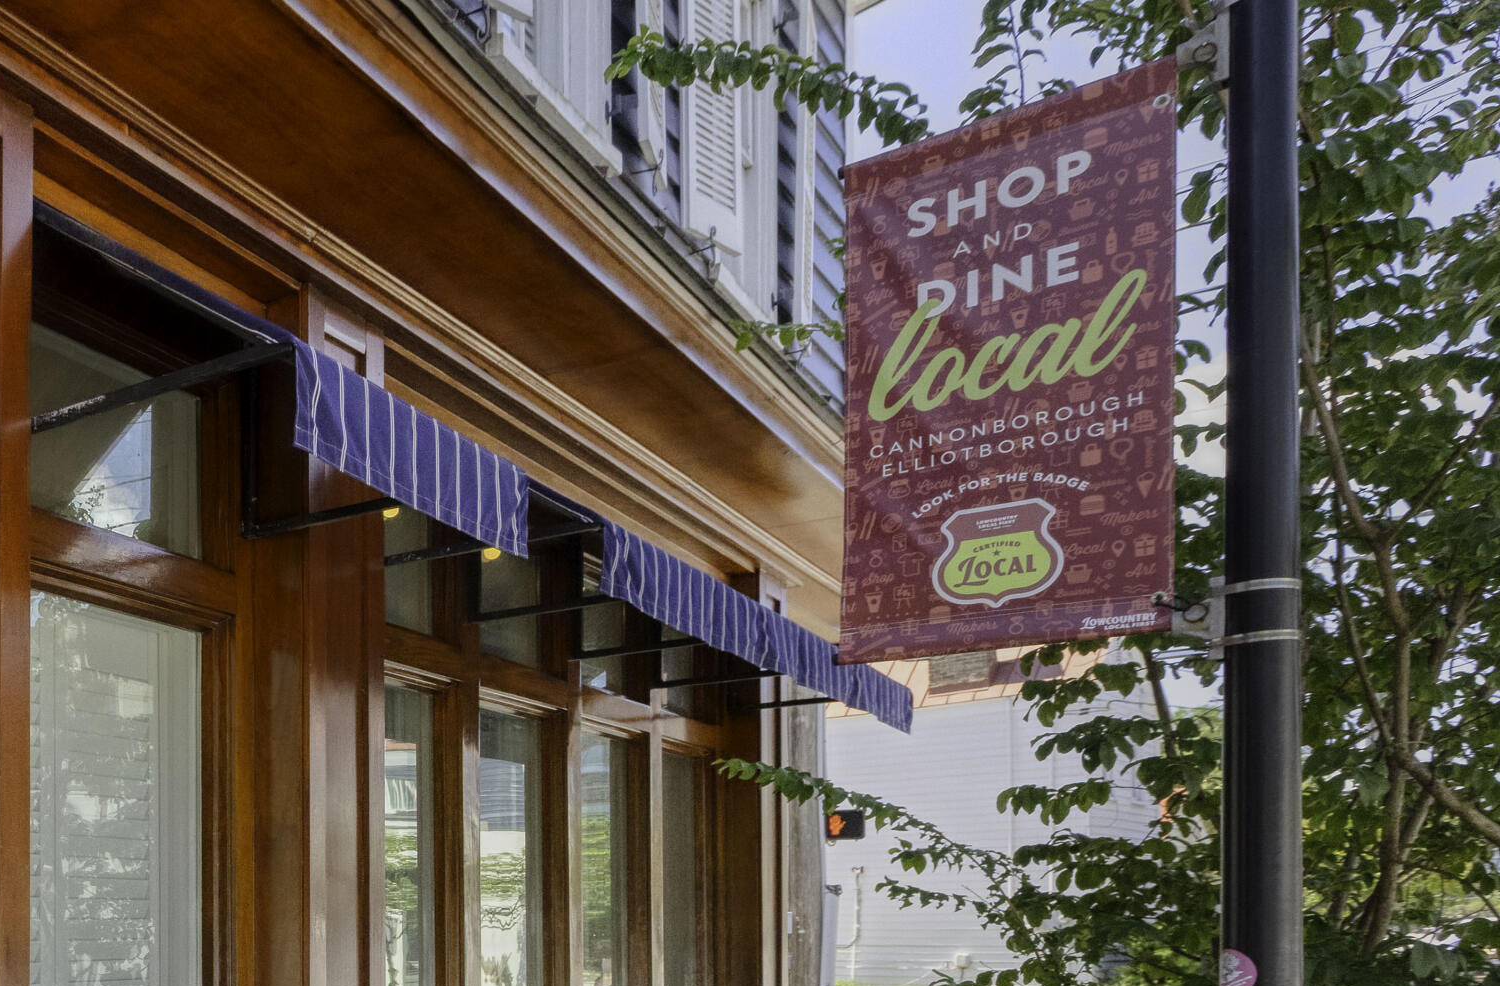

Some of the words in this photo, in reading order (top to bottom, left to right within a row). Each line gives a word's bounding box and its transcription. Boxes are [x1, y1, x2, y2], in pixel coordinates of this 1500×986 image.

[907, 150, 1092, 238] SHOP
[953, 223, 1033, 259] AND
[916, 241, 1080, 320] DINE
[867, 268, 1148, 422] local
[869, 391, 1144, 458] CANNONBOROUGH
[881, 417, 1129, 478] ELLIOTBOROUGH
[911, 489, 955, 519] LOOK
[958, 475, 991, 494] FOR
[995, 471, 1028, 484] THE
[1032, 471, 1090, 493] BADGE
[973, 541, 1021, 553] CERTIFIED
[1079, 612, 1158, 630] LOWCOUNTRY
[1103, 623, 1131, 631] LOCAL
[1131, 620, 1156, 628] FIRST
